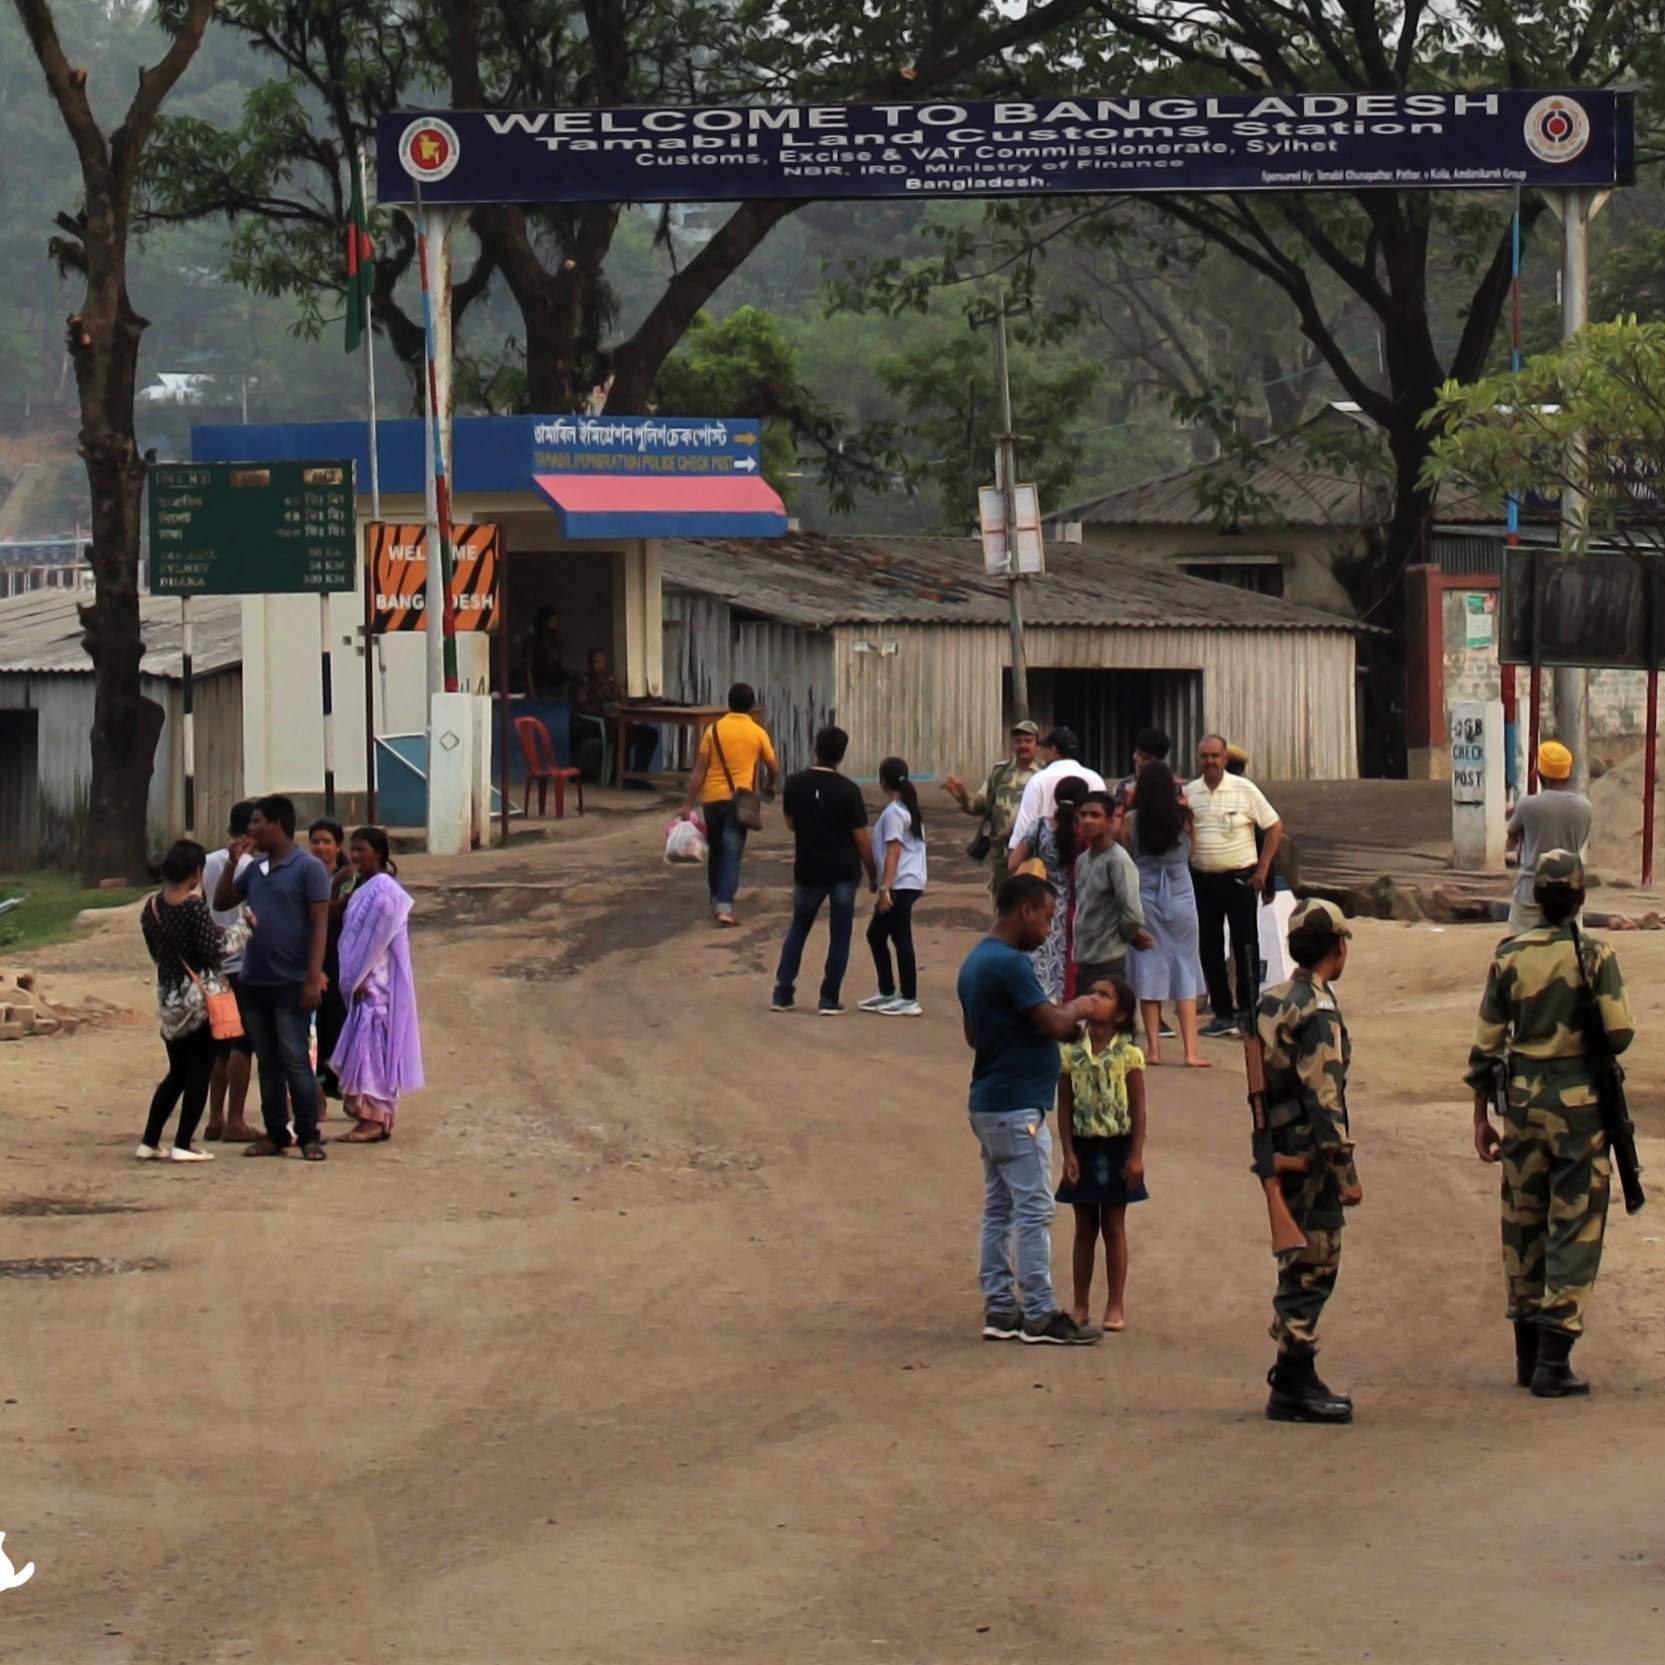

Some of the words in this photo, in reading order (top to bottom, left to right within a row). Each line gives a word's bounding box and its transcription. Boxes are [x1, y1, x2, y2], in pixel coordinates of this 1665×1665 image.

[484, 106, 849, 134] WELCOME
[873, 104, 968, 126] TO
[994, 94, 1499, 124] BANGLADESH
[535, 133, 758, 151] Tamabil
[782, 130, 924, 147] Land
[945, 124, 1210, 143] Customs
[1233, 120, 1443, 136] Station
[635, 152, 768, 167] Customs,
[779, 149, 871, 164] Excise
[882, 149, 902, 162] &
[910, 146, 966, 161] VAT
[974, 141, 1236, 159] Commissionerate,
[1246, 139, 1339, 156] Sylhet
[925, 162, 1033, 176] Ministry
[1041, 160, 1070, 171] of
[1077, 158, 1185, 170] Finance
[905, 177, 1051, 192] Bangladesh.
[574, 453, 640, 470] IMMIGRATION
[641, 454, 676, 471] POLICE
[678, 455, 709, 472] CHECK
[388, 544, 477, 561] WELME
[376, 593, 494, 610] BANGESH
[1453, 744, 1485, 761] CHECK
[1454, 770, 1483, 788] POST
